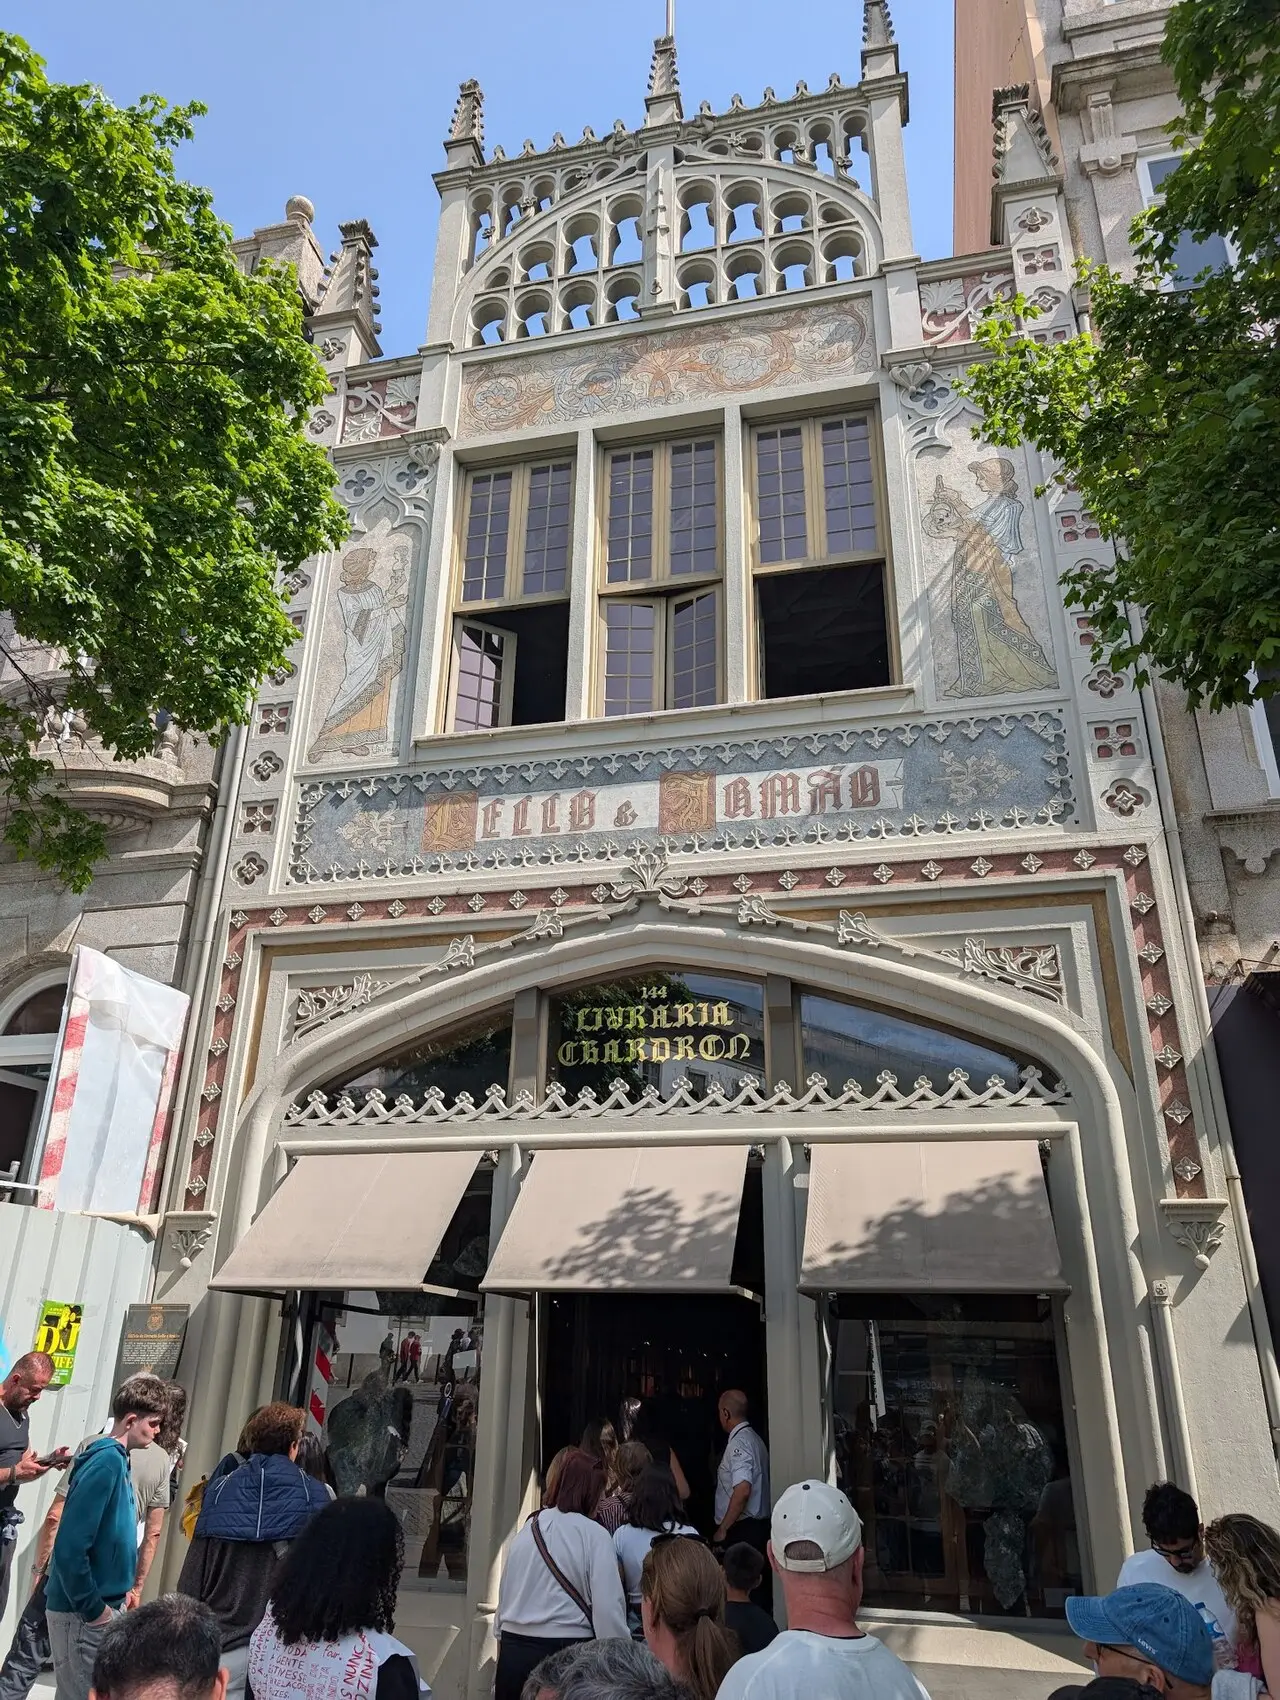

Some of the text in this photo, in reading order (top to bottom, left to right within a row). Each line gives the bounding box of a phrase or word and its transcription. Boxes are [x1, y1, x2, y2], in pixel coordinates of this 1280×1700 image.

[422, 764, 882, 852] LELLO & IRMÃO
[641, 985, 668, 999] 144
[576, 1001, 734, 1032] LIVRARIA
[557, 1033, 751, 1067] CHARDRON
[51, 1356, 74, 1369] IFE
